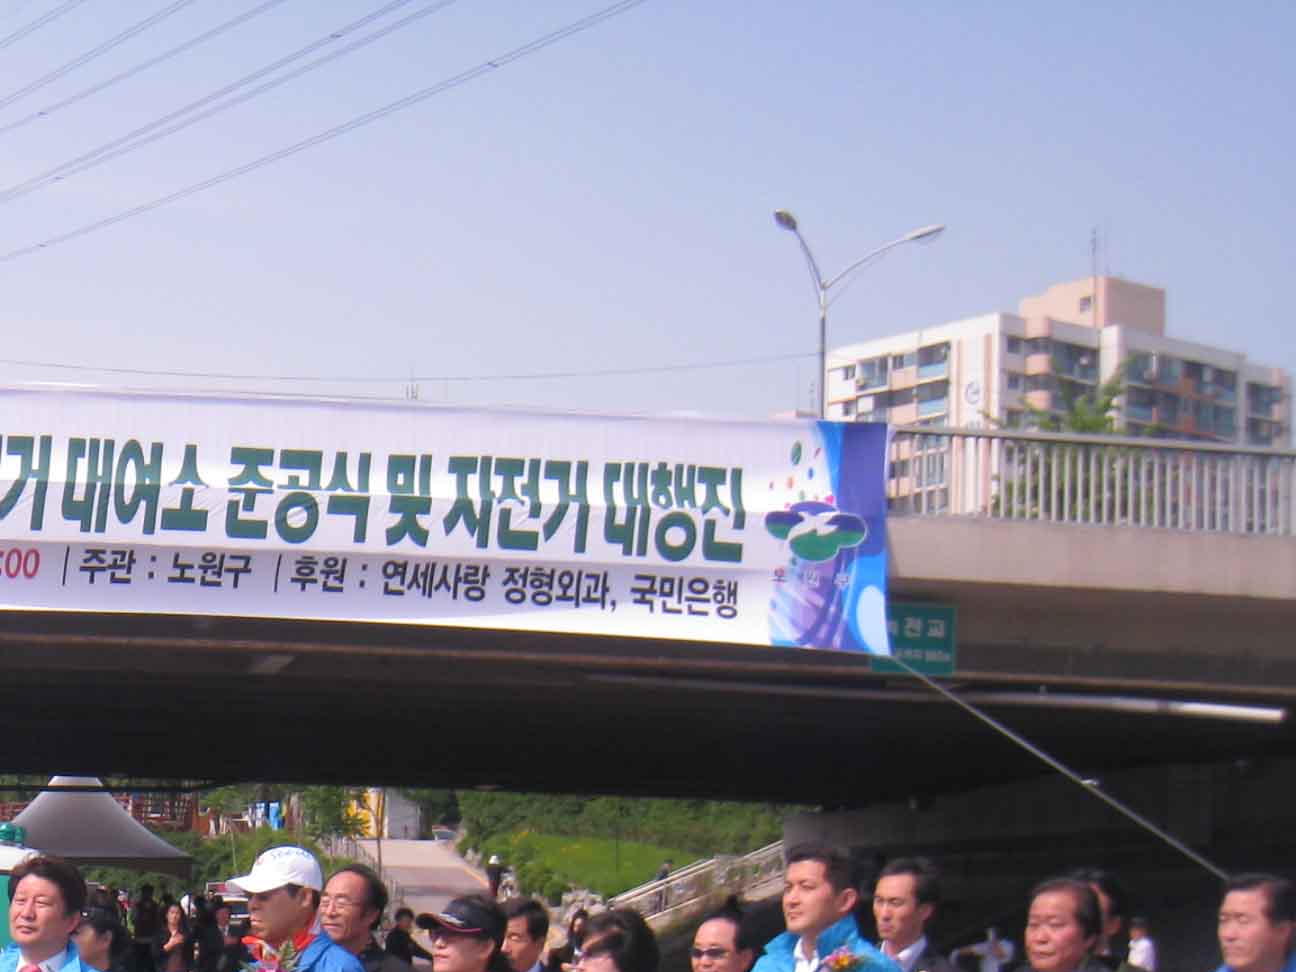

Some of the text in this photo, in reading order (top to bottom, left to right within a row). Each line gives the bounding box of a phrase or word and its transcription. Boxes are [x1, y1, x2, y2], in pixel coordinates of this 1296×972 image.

[61, 438, 209, 535] 대여소
[224, 446, 371, 545] 준공식
[386, 454, 434, 548] 및
[442, 456, 590, 554] 자전거
[603, 461, 746, 563] 대행진
[167, 551, 253, 588] 노원구
[381, 560, 490, 601] 연세사랑
[503, 565, 616, 612] 정형외과,
[630, 573, 738, 619] 국민은행
